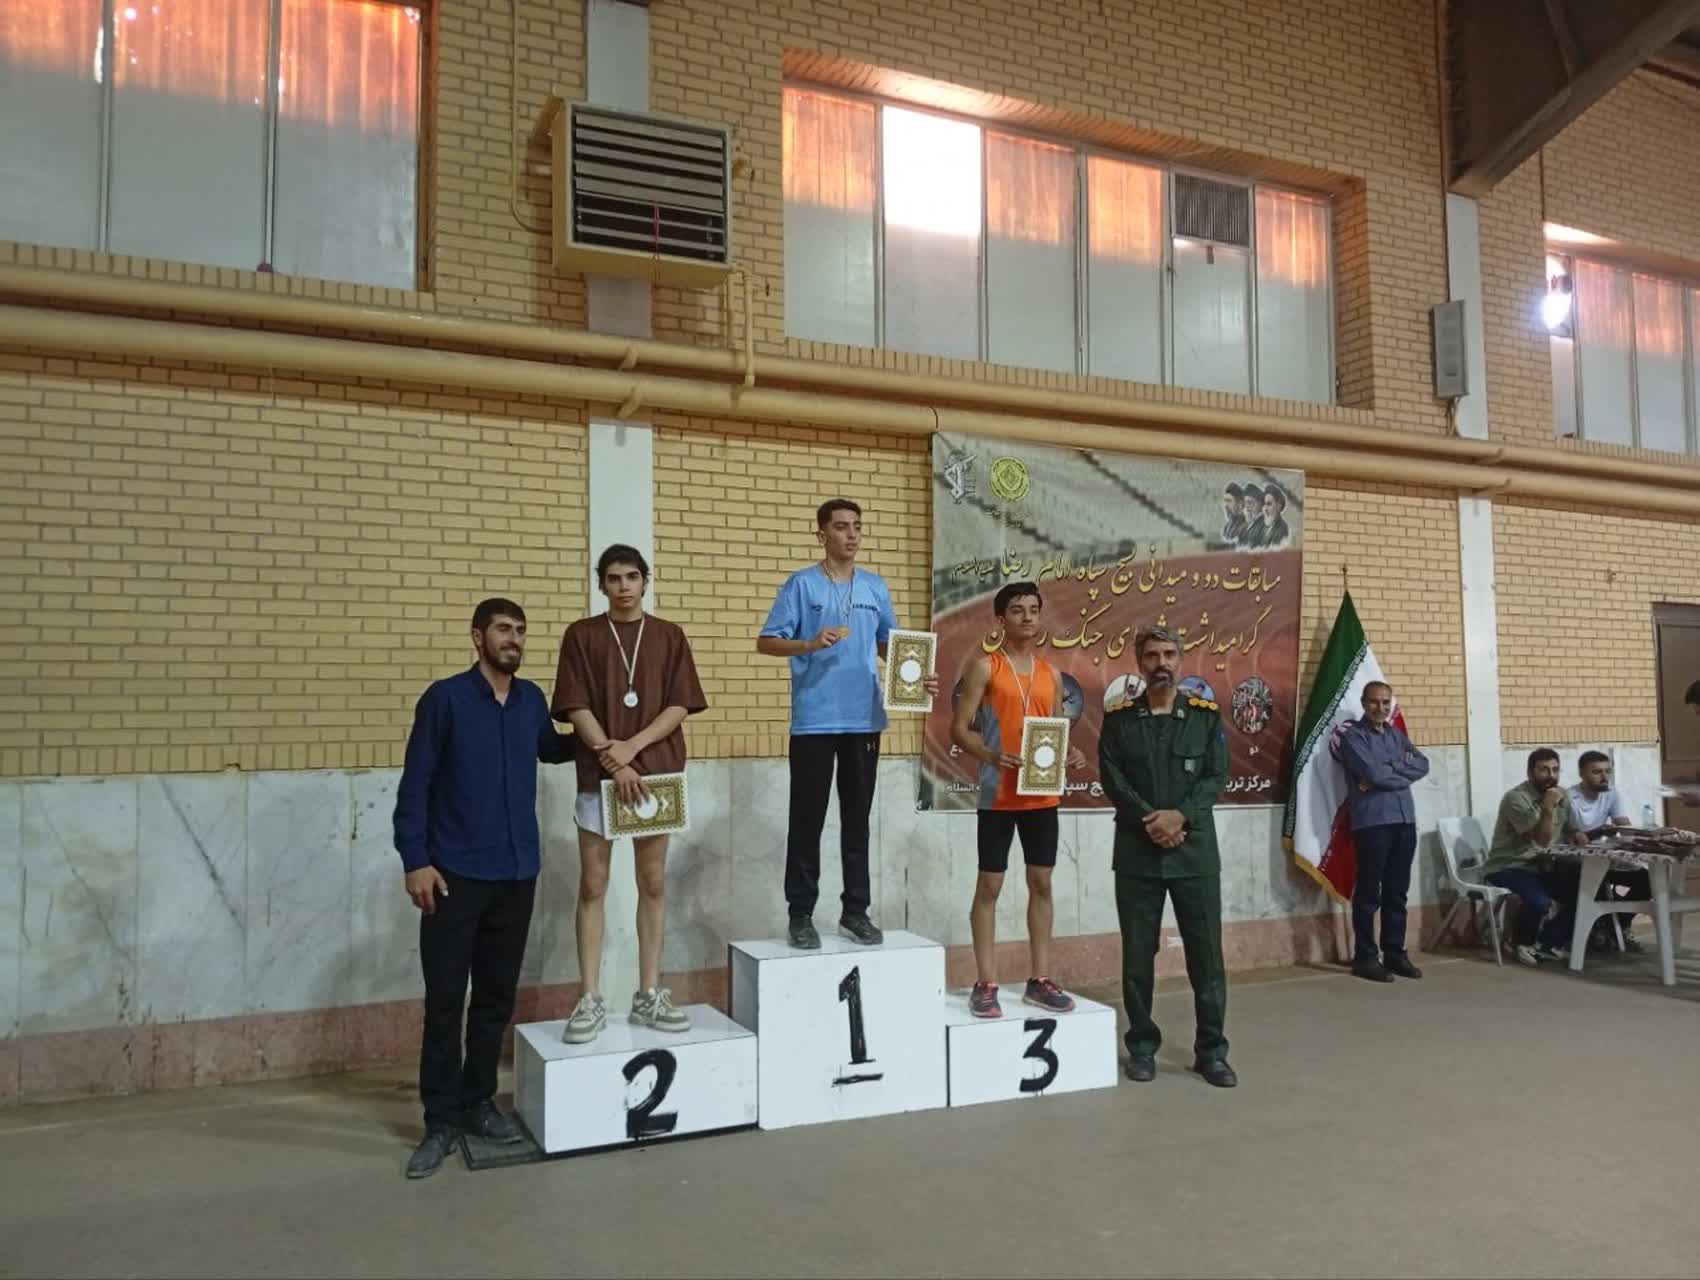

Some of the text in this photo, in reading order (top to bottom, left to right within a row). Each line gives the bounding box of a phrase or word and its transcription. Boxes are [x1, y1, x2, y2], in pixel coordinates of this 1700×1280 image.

[1001, 545, 1032, 578] رضا
[1036, 551, 1072, 587] امام
[1076, 553, 1108, 601] سپاه
[1111, 538, 1137, 595] بسیج
[1138, 544, 1188, 604] میدانی
[1222, 566, 1281, 603] مسابقات
[1244, 775, 1271, 792] مرکز
[837, 965, 877, 1065] 1
[1018, 1018, 1060, 1094] 3
[621, 1048, 679, 1139] 2
